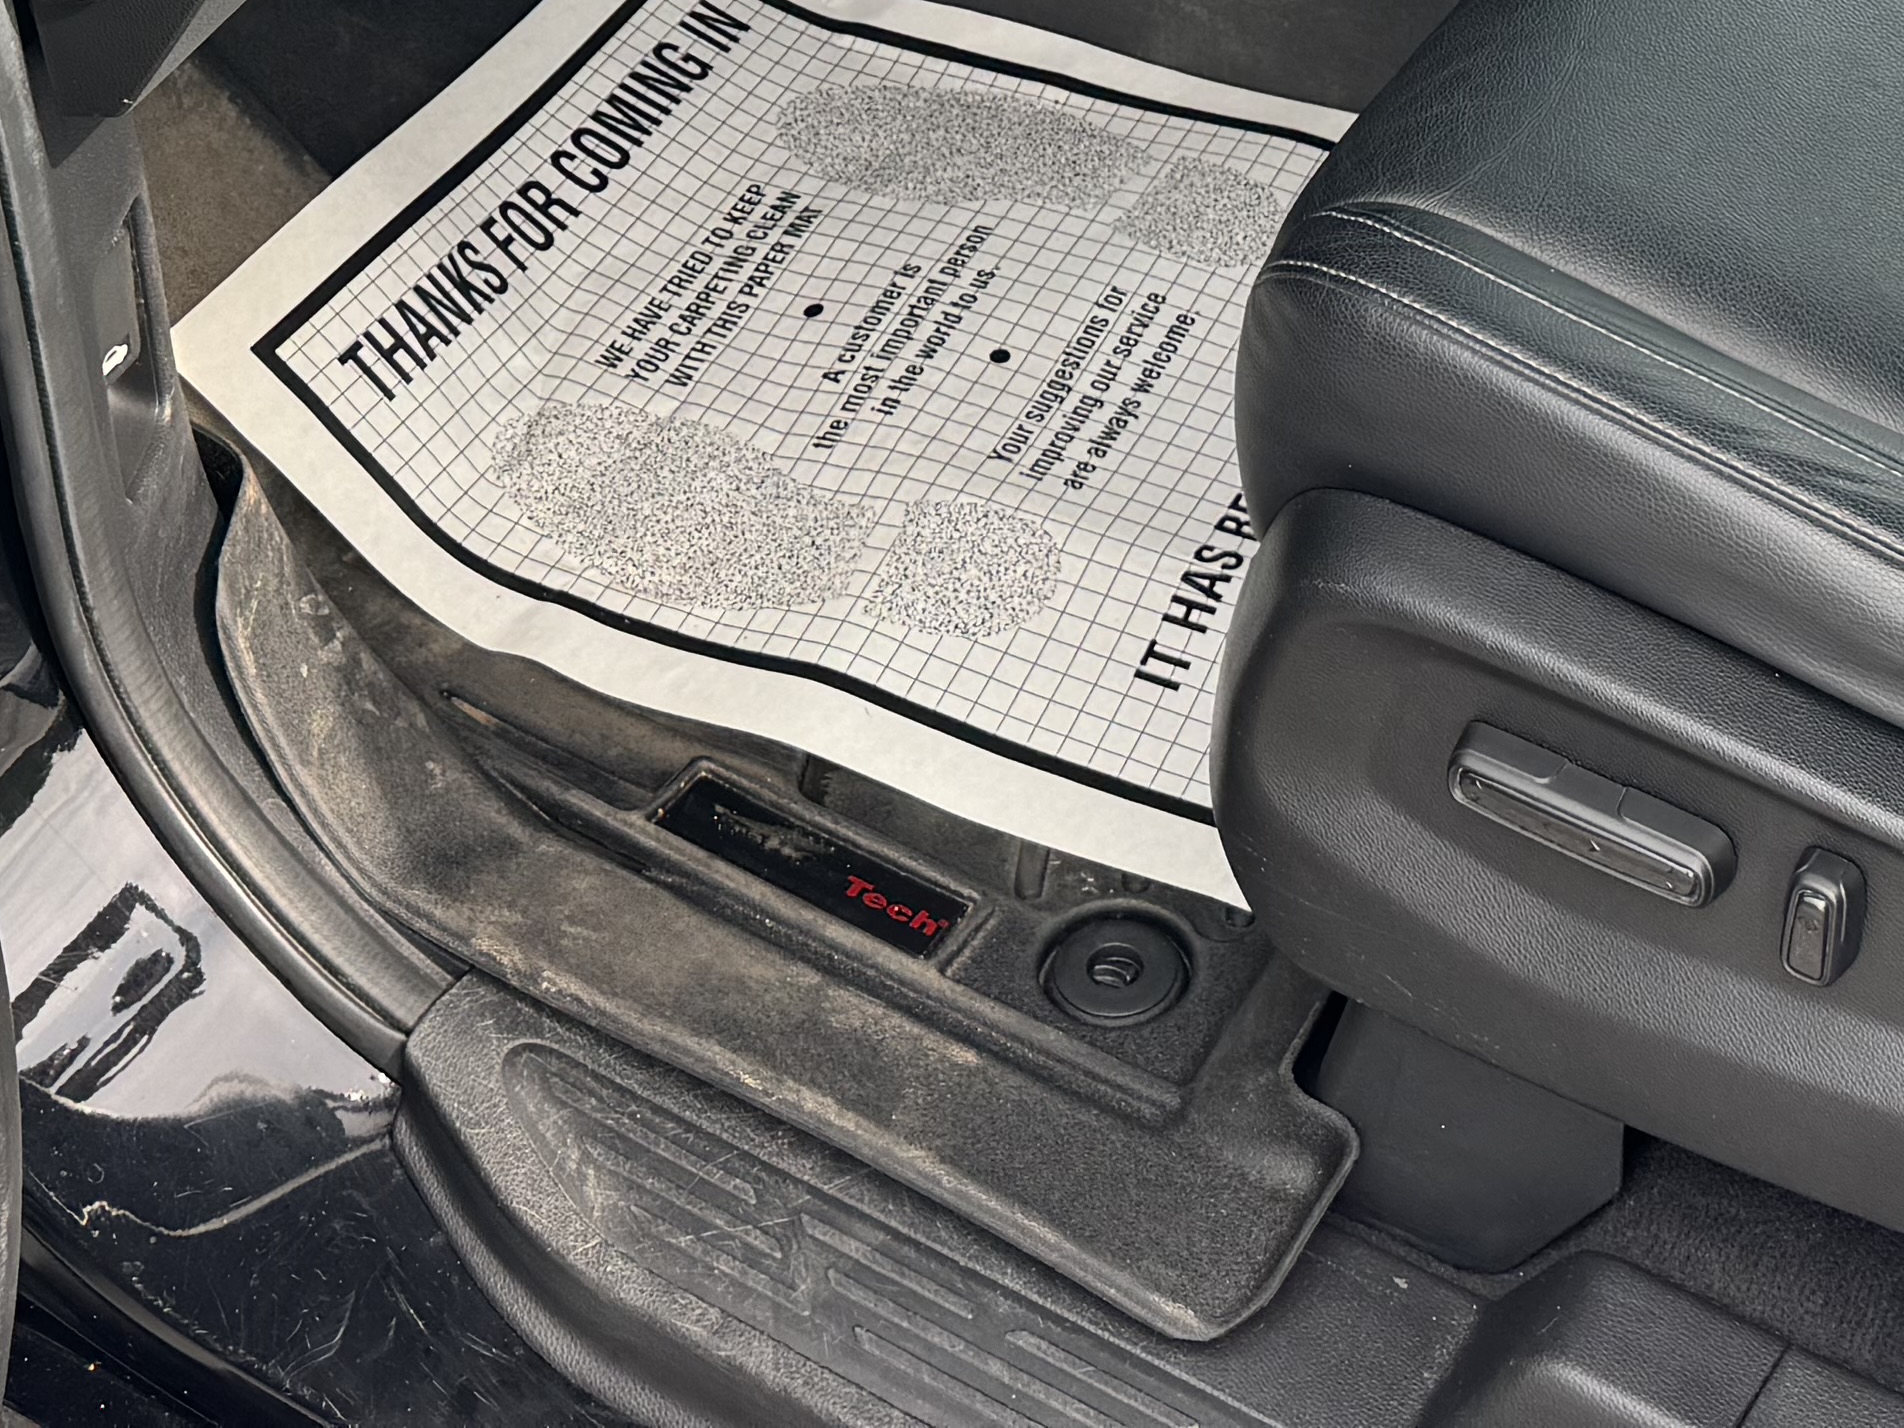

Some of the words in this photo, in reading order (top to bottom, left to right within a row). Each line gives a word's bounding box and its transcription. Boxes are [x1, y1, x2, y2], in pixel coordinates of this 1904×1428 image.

[337, 240, 509, 402] THANKS
[479, 180, 583, 272] FOR
[550, 42, 714, 193] COMING
[594, 339, 634, 370] WE
[620, 296, 672, 342] HAVE
[658, 249, 713, 298] TRIED
[701, 226, 734, 249] TO
[722, 183, 767, 226] KEEP
[624, 337, 681, 382] YOUR
[668, 244, 757, 337] CARPETING
[745, 191, 802, 241] CLEAN
[665, 339, 717, 388] WITH
[703, 300, 750, 339] THIS
[738, 240, 795, 298] PAPER
[782, 205, 823, 239] MAT
[812, 419, 849, 450] the
[840, 365, 885, 413] most
[870, 278, 947, 361] important
[938, 223, 994, 279] person
[822, 368, 846, 384] A
[837, 278, 906, 364] customer
[894, 263, 922, 279] is
[871, 395, 901, 416] in
[888, 364, 924, 392] the
[915, 311, 963, 360] world
[949, 293, 978, 310] to
[986, 423, 1034, 463] Your
[1025, 314, 1110, 423] suggestions
[1095, 285, 1128, 313] for
[1019, 393, 1104, 482] improving
[1090, 359, 1122, 392] our
[1112, 291, 1167, 358] service
[1063, 460, 1097, 490] are
[1086, 397, 1142, 459] always
[1131, 310, 1202, 394] welcome.
[1134, 638, 1192, 692] IT
[1161, 544, 1244, 634] HAS
[846, 875, 943, 937] Tech
